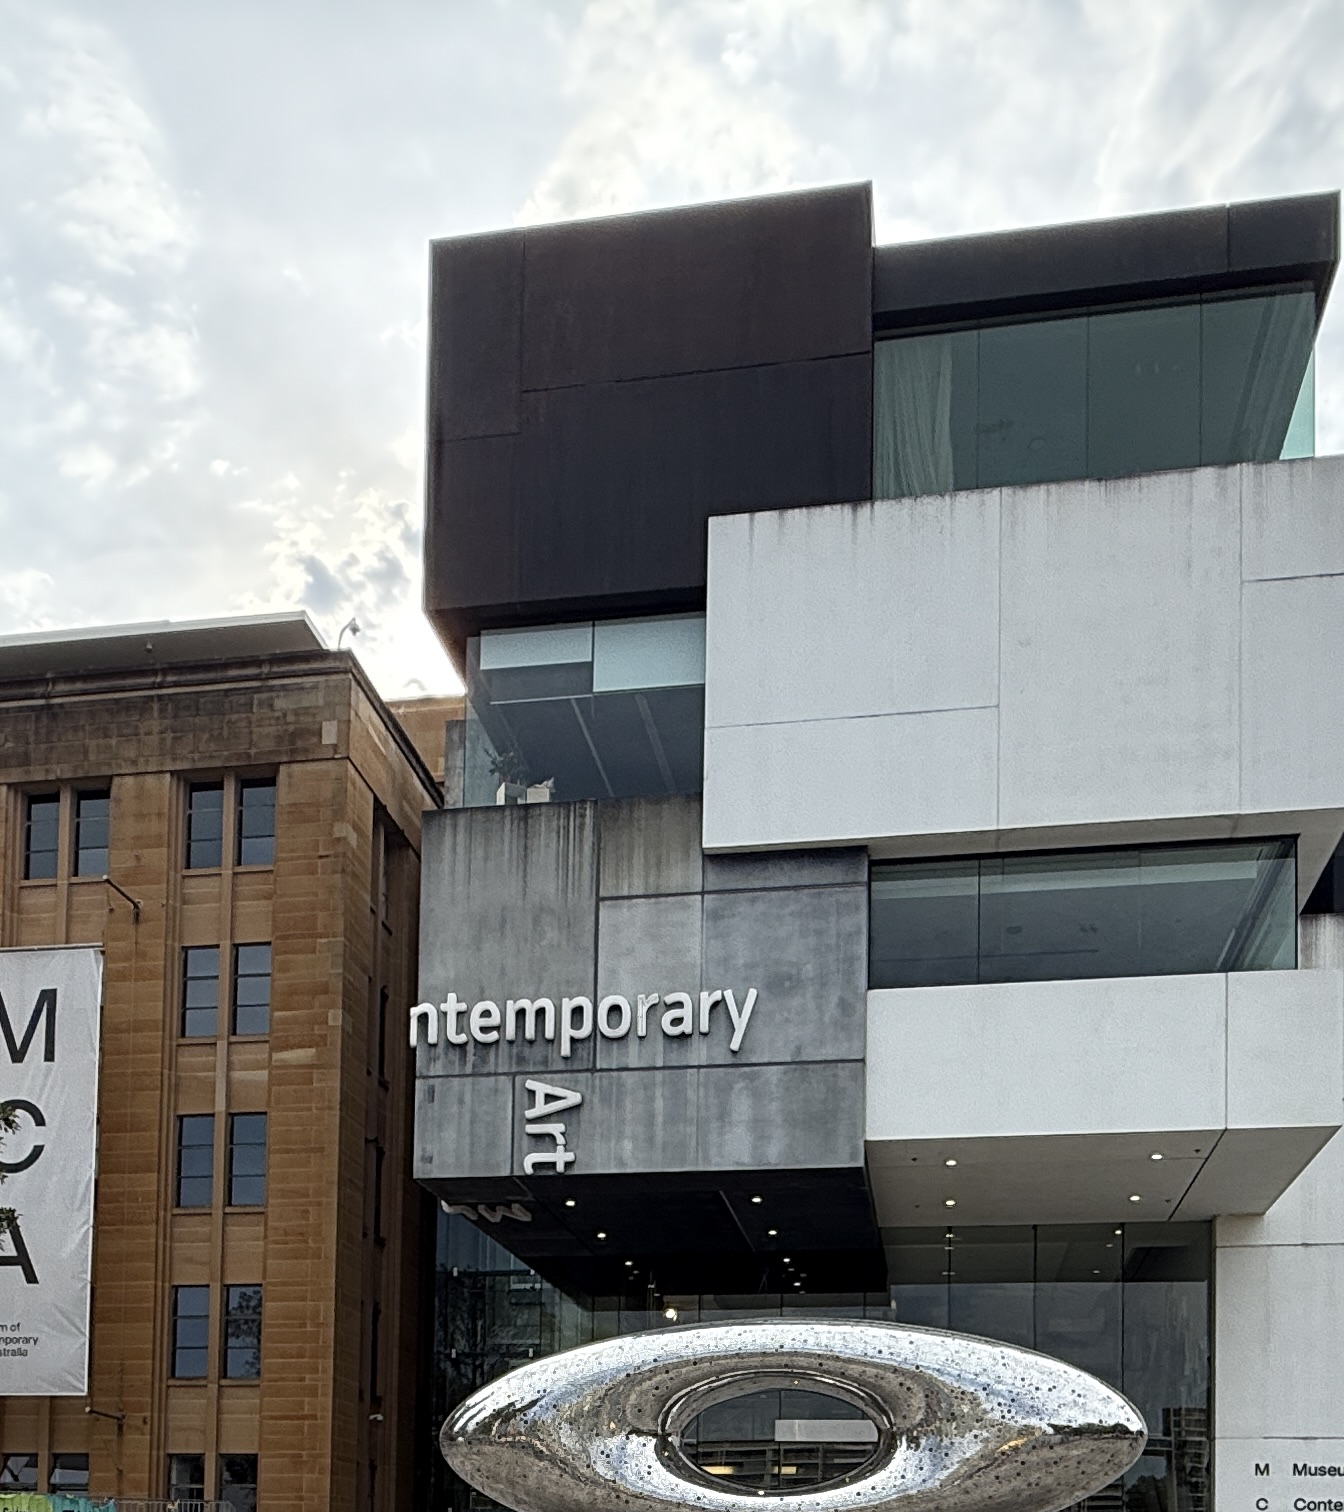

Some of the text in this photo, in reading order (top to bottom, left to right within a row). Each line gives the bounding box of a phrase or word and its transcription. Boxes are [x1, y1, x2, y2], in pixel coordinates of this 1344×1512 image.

[409, 988, 757, 1058] ntemporary
[523, 1078, 583, 1176] Art
[9, 1322, 21, 1333] of
[1254, 1463, 1270, 1477] M
[1255, 1497, 1269, 1511] C
